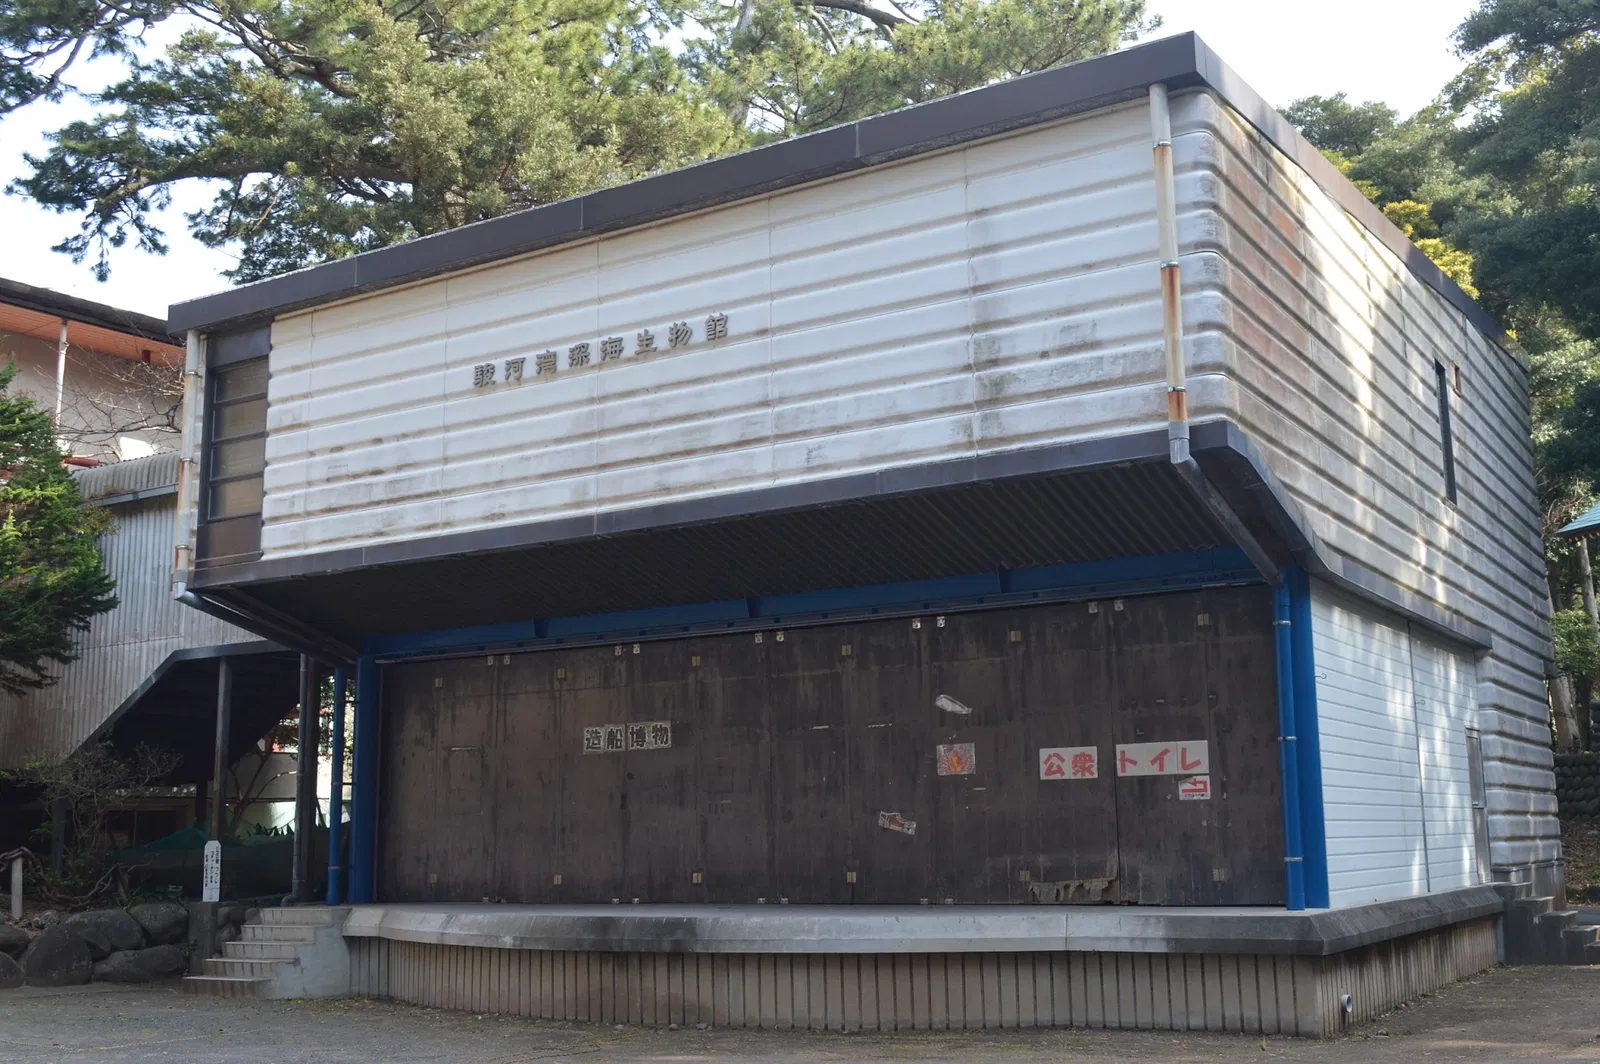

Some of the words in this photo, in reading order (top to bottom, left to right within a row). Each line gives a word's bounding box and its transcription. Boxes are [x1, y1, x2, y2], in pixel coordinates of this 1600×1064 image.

[473, 313, 729, 388] 駿河湾深海生物館
[585, 723, 669, 750] 造船博物
[1043, 751, 1095, 777] 公衆
[1118, 747, 1202, 774] トイレ
